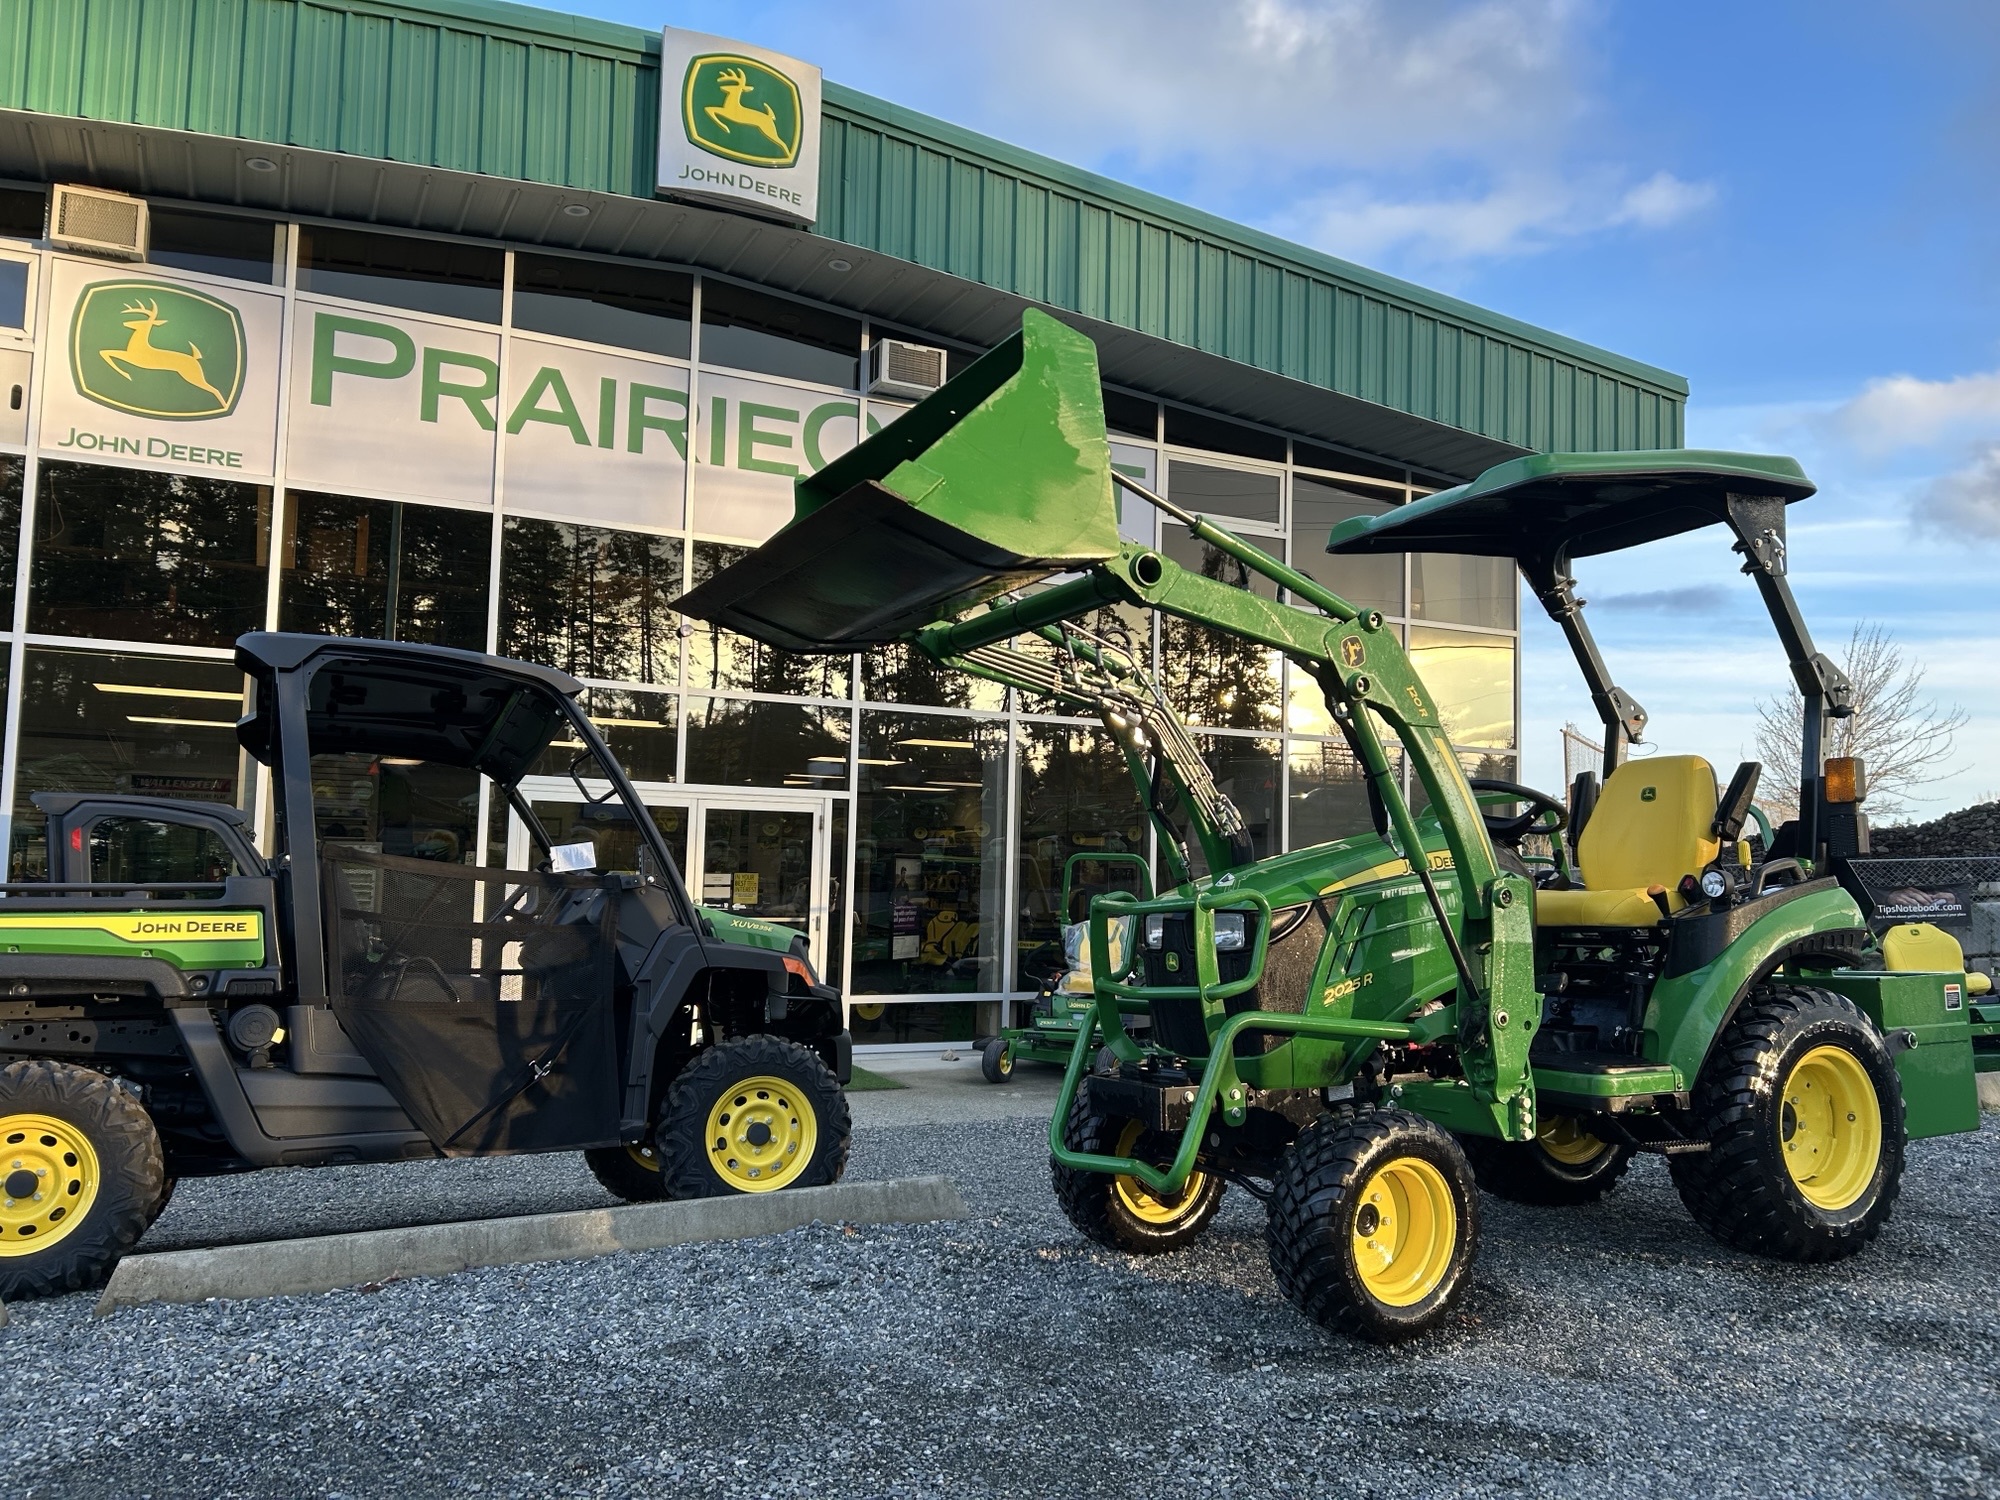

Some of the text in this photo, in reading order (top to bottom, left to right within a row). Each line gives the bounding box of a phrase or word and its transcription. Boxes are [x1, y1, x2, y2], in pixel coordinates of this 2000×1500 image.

[678, 165, 802, 206] JOHN DEERE
[57, 427, 243, 468] JOHN DEERE
[1877, 903, 1962, 915] TipsNotebook.com
[131, 921, 247, 934] JOHN DEERE
